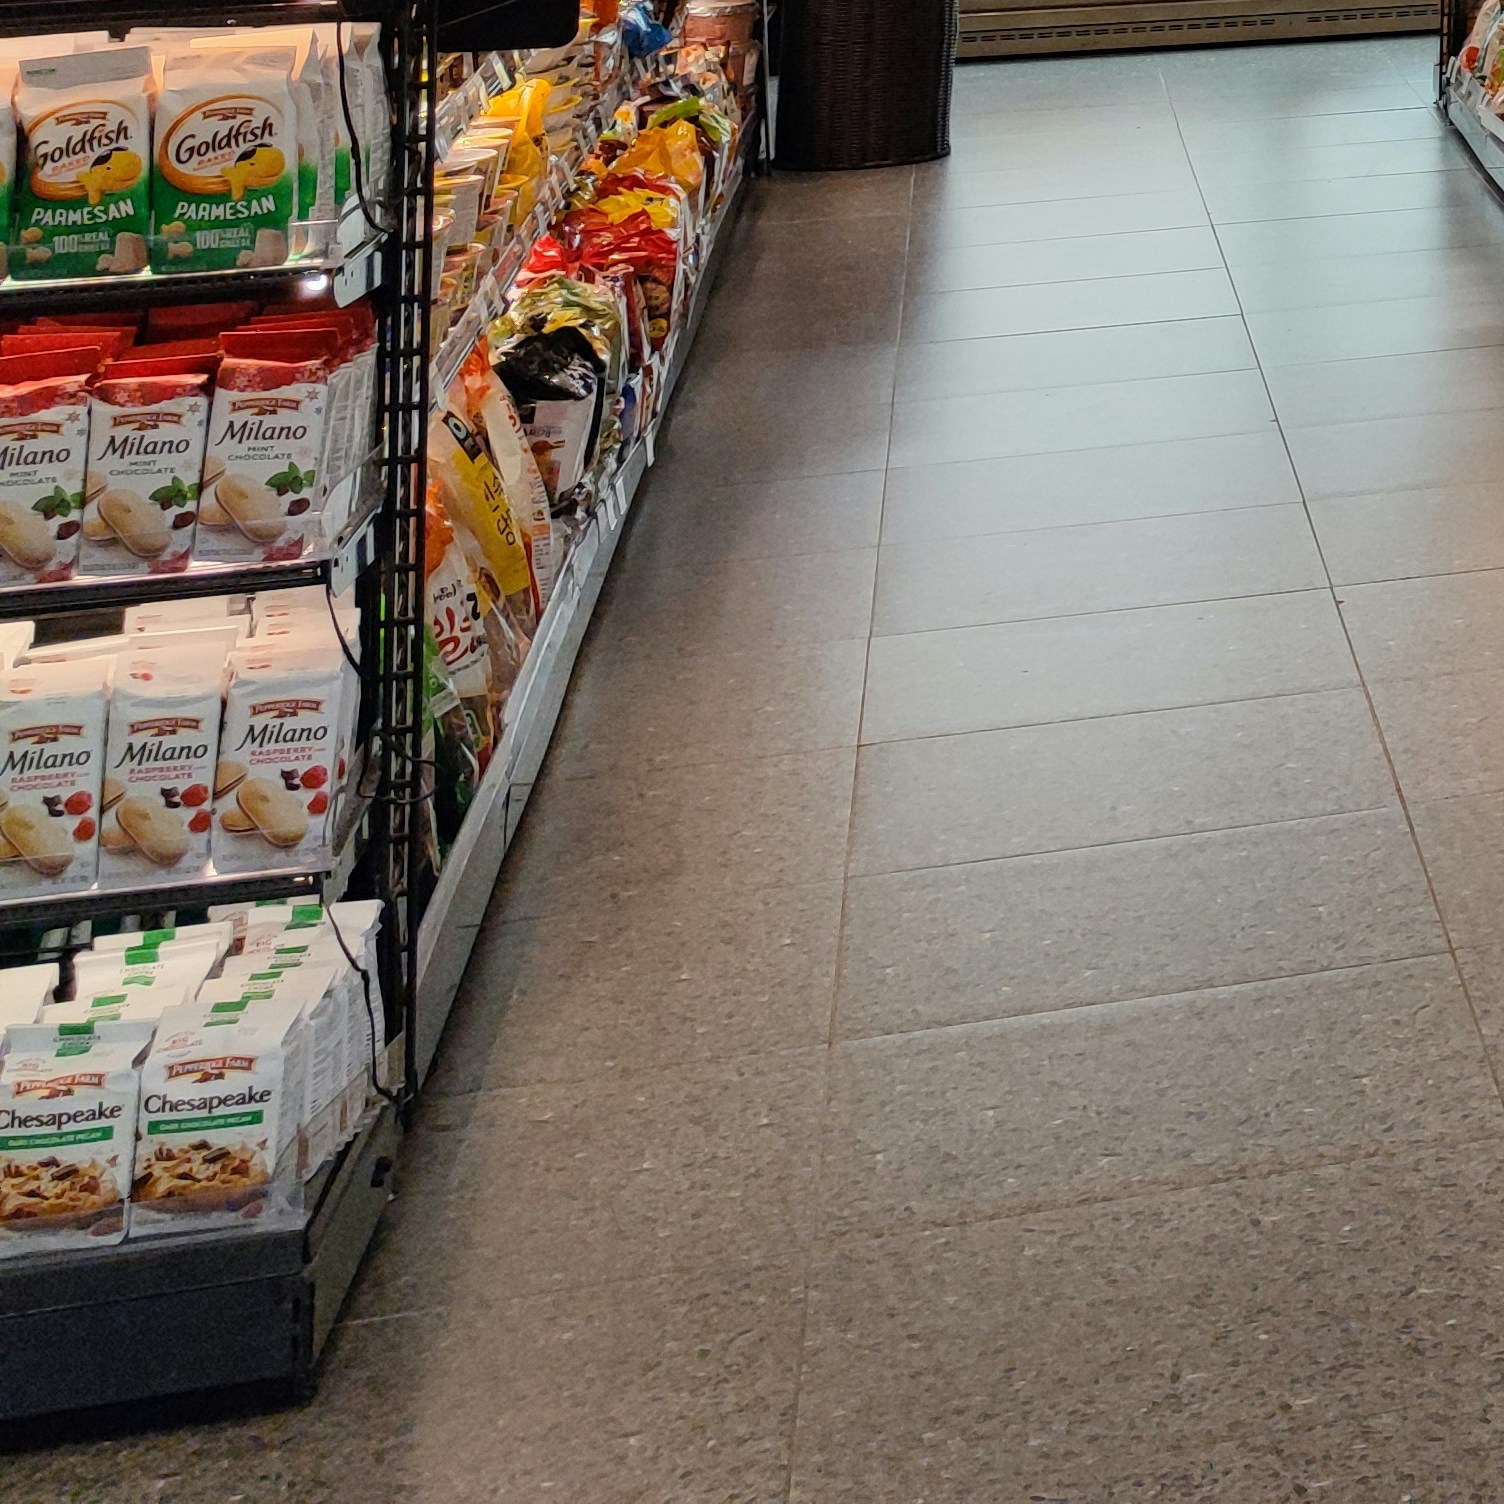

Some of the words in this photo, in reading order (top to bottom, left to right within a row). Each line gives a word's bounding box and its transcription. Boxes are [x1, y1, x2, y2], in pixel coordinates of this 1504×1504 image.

[35, 119, 130, 170] Goldfish
[175, 116, 274, 164] Goldfish
[31, 199, 134, 225] PARMESAN
[174, 195, 275, 220] PARMESAN
[215, 421, 308, 446] Milano
[98, 435, 190, 460] Milano
[228, 453, 293, 461] CHOCOLATE
[0, 477, 57, 486] HOCOLATE
[109, 468, 175, 476] CHOCOLATE
[235, 723, 328, 751] Milano
[0, 749, 91, 776] Milano
[115, 742, 208, 768] Milano
[249, 754, 313, 765] CHOCOLATE
[251, 747, 314, 756] RASPBERRY
[11, 772, 77, 784] RASPBERRY
[128, 772, 193, 783] CHOCOLATE
[129, 764, 195, 775] RASPBERRY
[10, 781, 76, 791] CHOCOLATE
[225, 1057, 254, 1070] FARM
[143, 1086, 272, 1114] Chesapeake
[0, 1103, 122, 1130] Chesapeake
